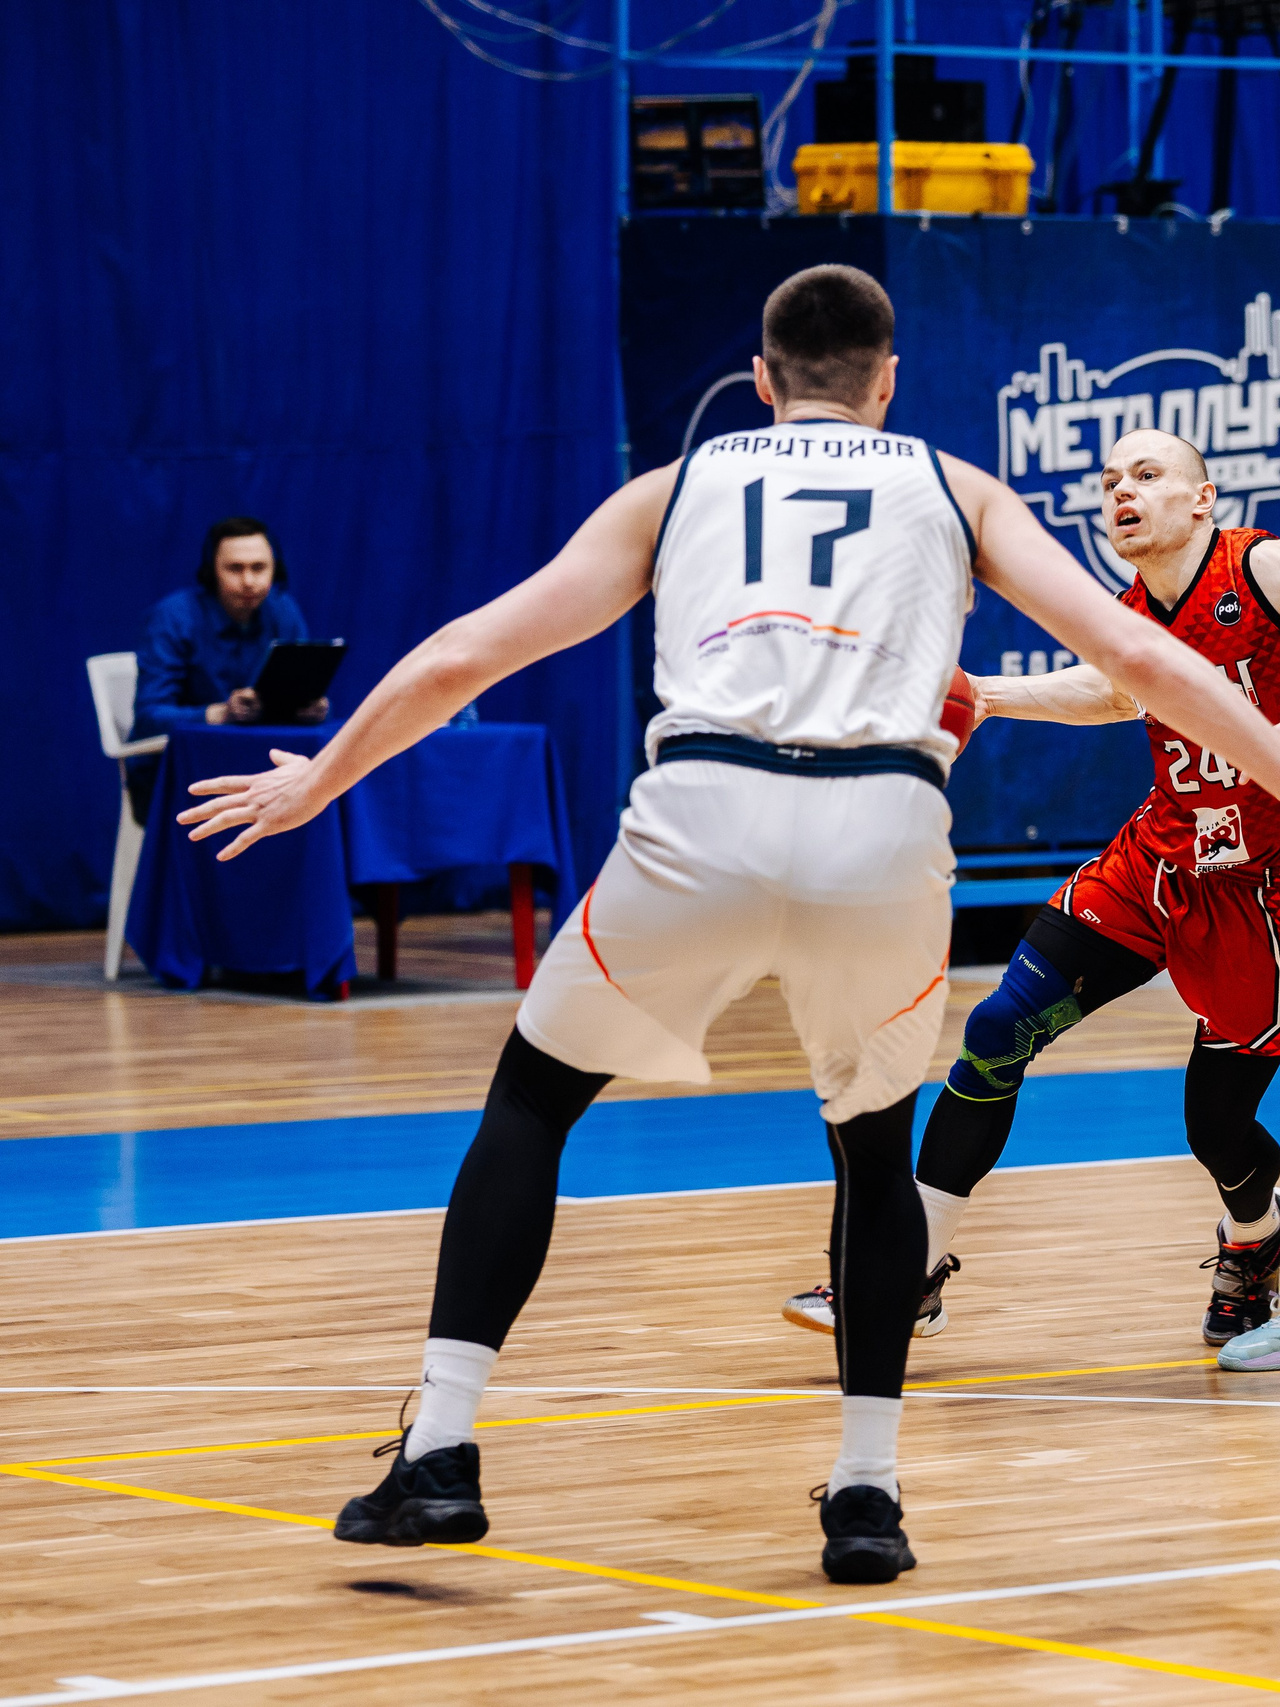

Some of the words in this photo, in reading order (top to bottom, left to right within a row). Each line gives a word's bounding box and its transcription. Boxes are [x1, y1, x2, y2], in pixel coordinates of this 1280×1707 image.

[710, 436, 914, 459] ХАРИТОНОВ
[743, 476, 873, 588] 17
[1163, 739, 1237, 793] 24
